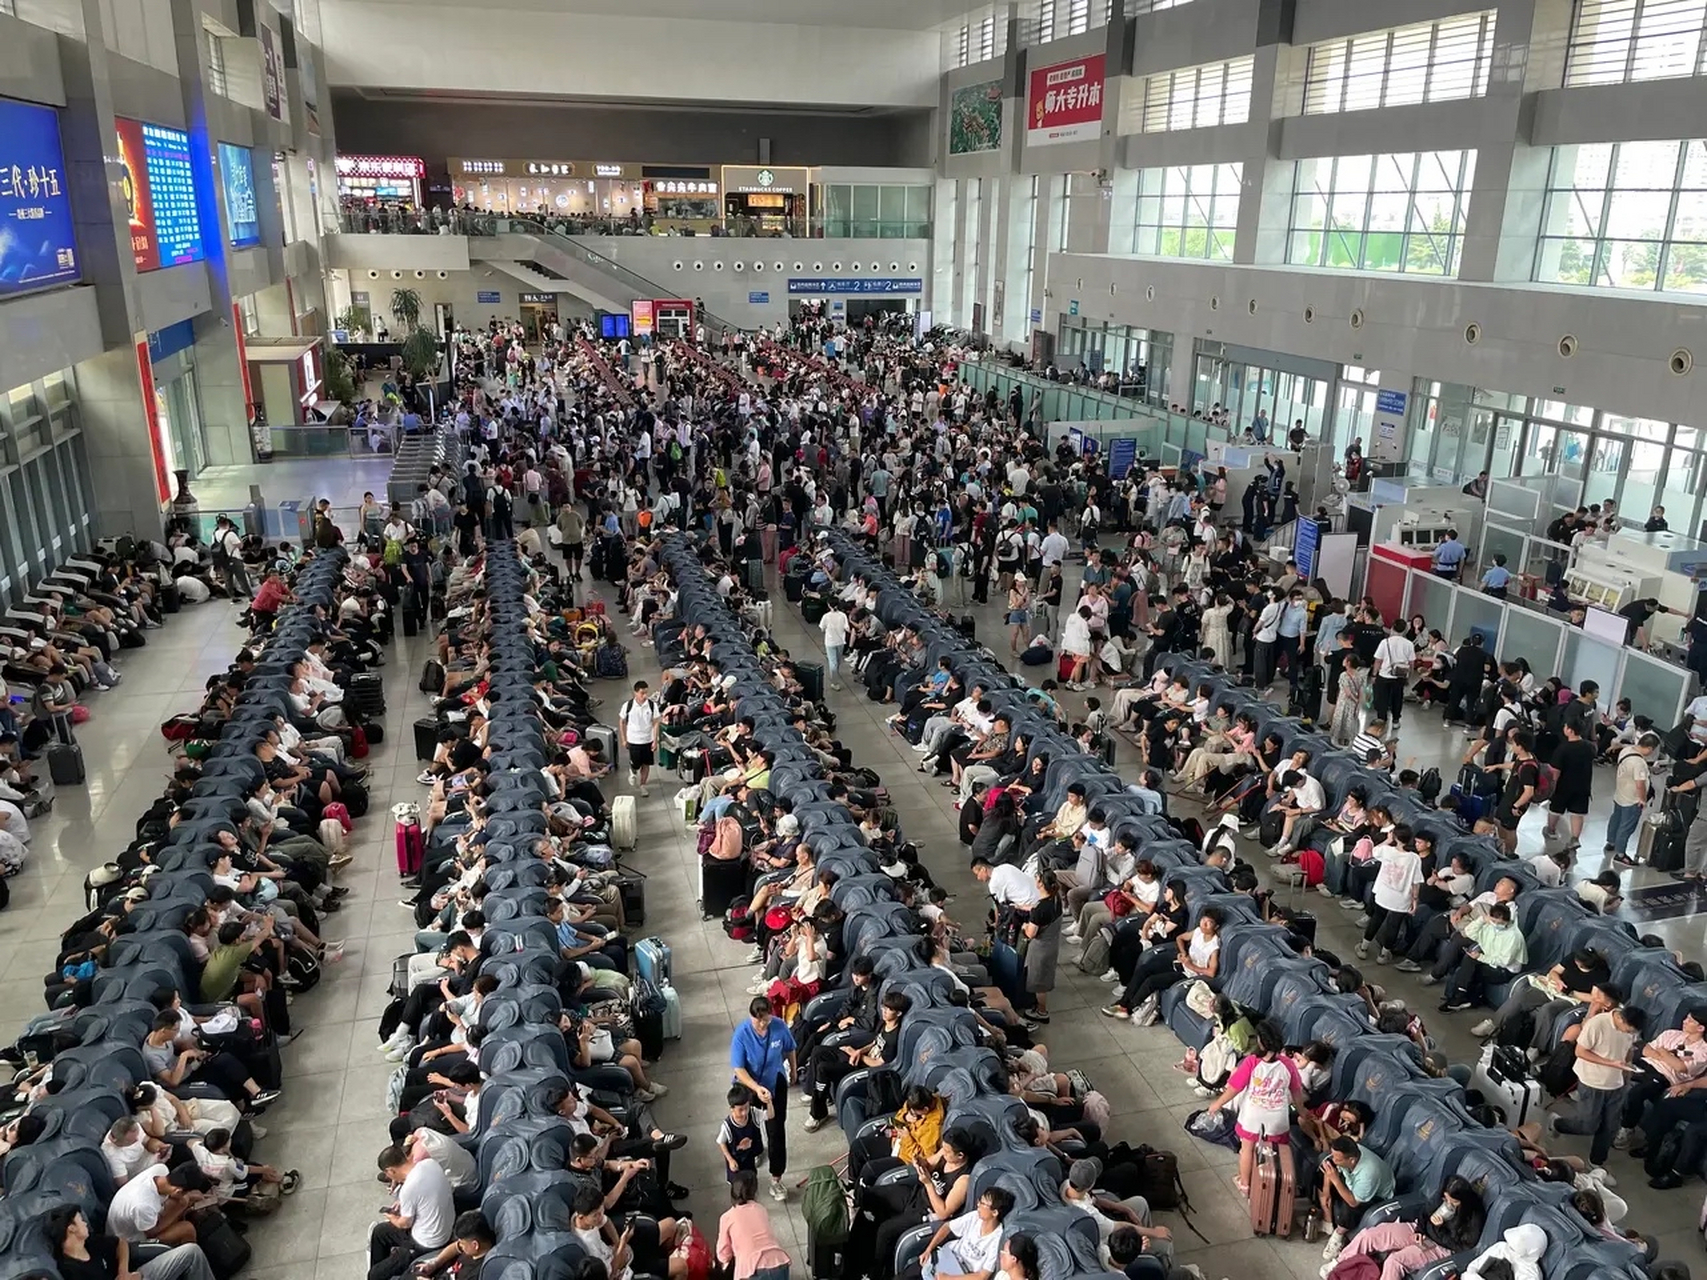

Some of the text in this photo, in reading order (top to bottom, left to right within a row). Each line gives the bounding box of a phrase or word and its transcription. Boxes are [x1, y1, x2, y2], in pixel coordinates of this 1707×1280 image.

[1045, 81, 1101, 114] 师大专升本
[854, 280, 860, 291] 2
[885, 280, 891, 291] 2
